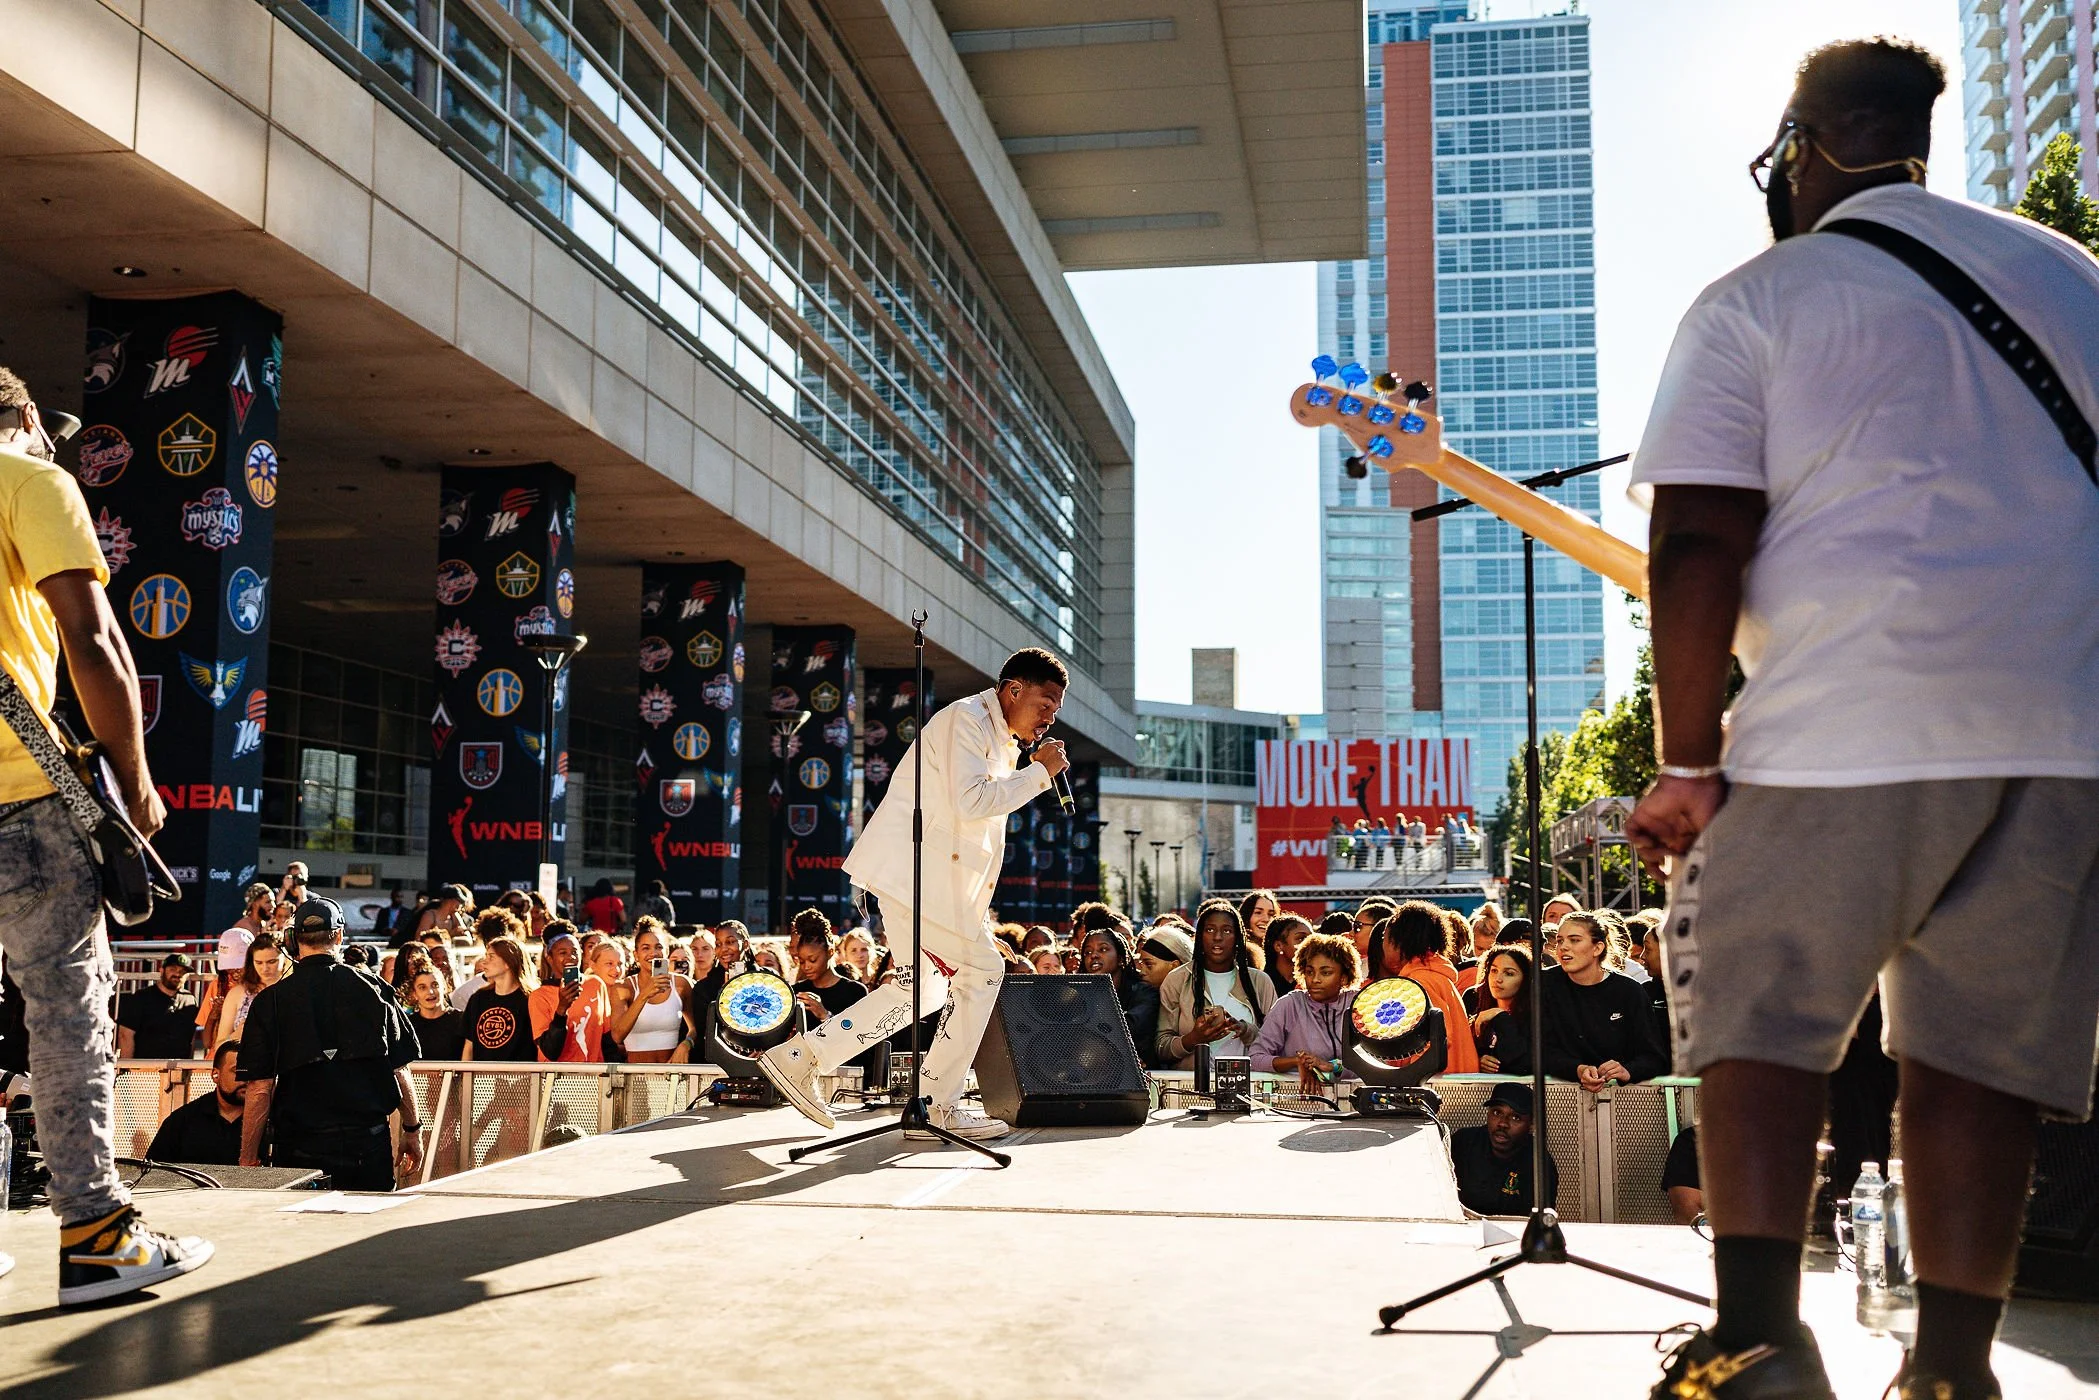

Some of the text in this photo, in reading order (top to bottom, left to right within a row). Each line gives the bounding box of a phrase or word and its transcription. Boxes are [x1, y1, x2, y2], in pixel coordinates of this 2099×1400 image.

[1256, 739, 1474, 807] MORE THAN
[157, 784, 235, 810] NBA
[469, 821, 543, 840] WNB
[209, 868, 232, 882] Google
